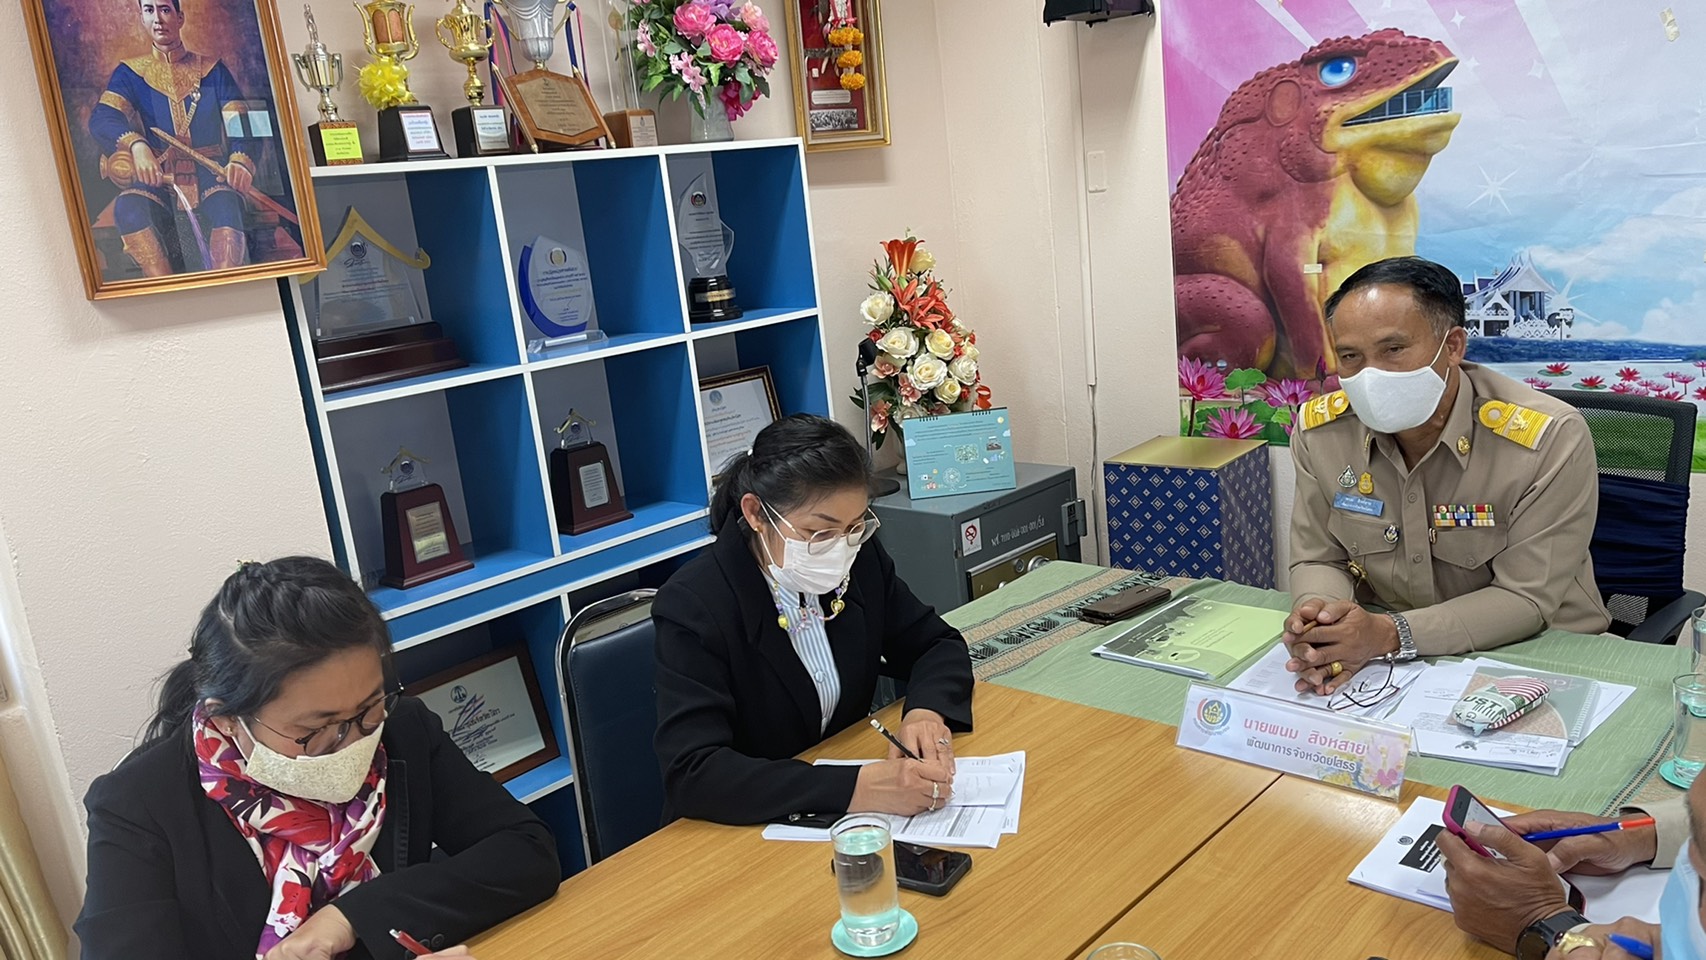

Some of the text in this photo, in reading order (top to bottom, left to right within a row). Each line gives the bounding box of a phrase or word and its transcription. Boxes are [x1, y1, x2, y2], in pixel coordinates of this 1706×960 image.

[1244, 718, 1299, 740] นายพนม
[1308, 729, 1366, 755] สิงห์สาย
[1246, 736, 1356, 771] พัฒนาการจังหวัดยโสธร
